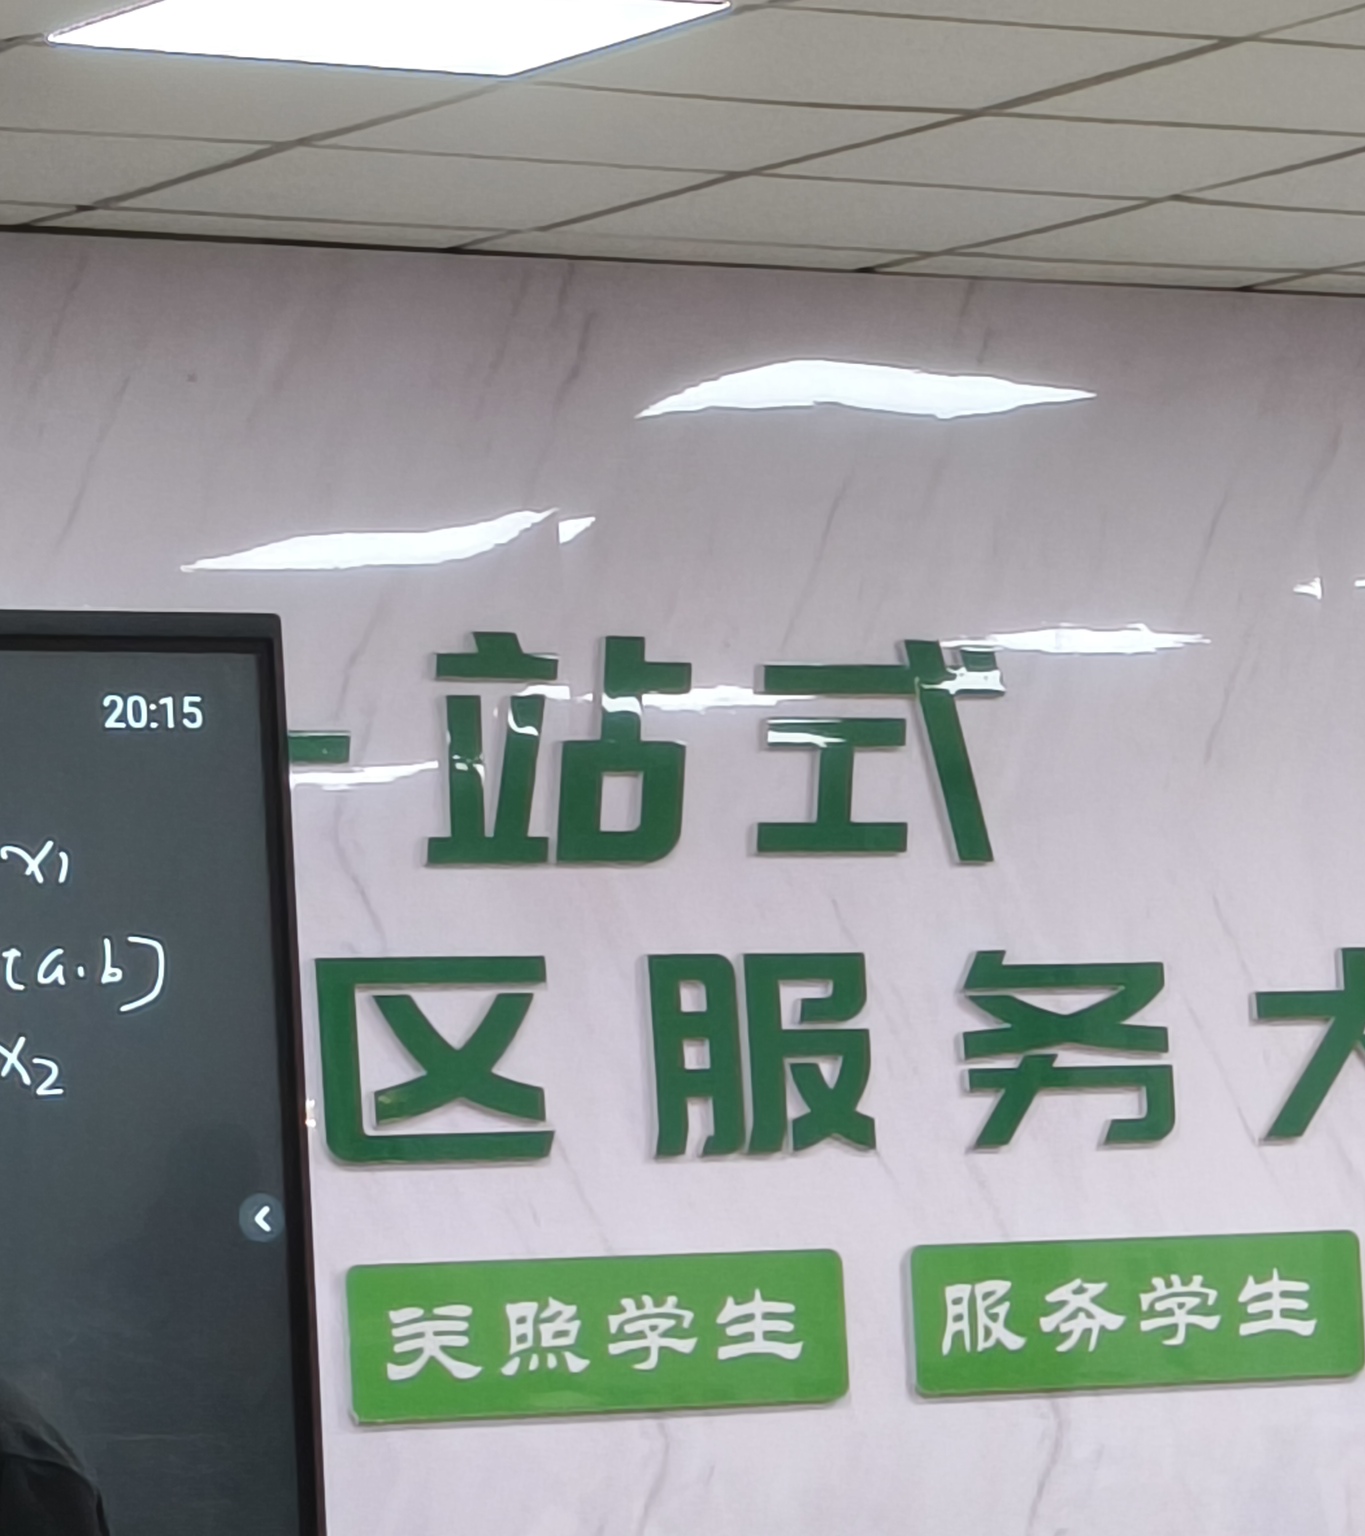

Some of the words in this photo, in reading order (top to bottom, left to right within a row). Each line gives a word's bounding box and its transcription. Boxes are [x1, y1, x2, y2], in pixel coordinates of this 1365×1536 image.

[101, 693, 205, 730] 20:15
[386, 1288, 804, 1382] 关照学生
[942, 1266, 1318, 1357] 服务学生
